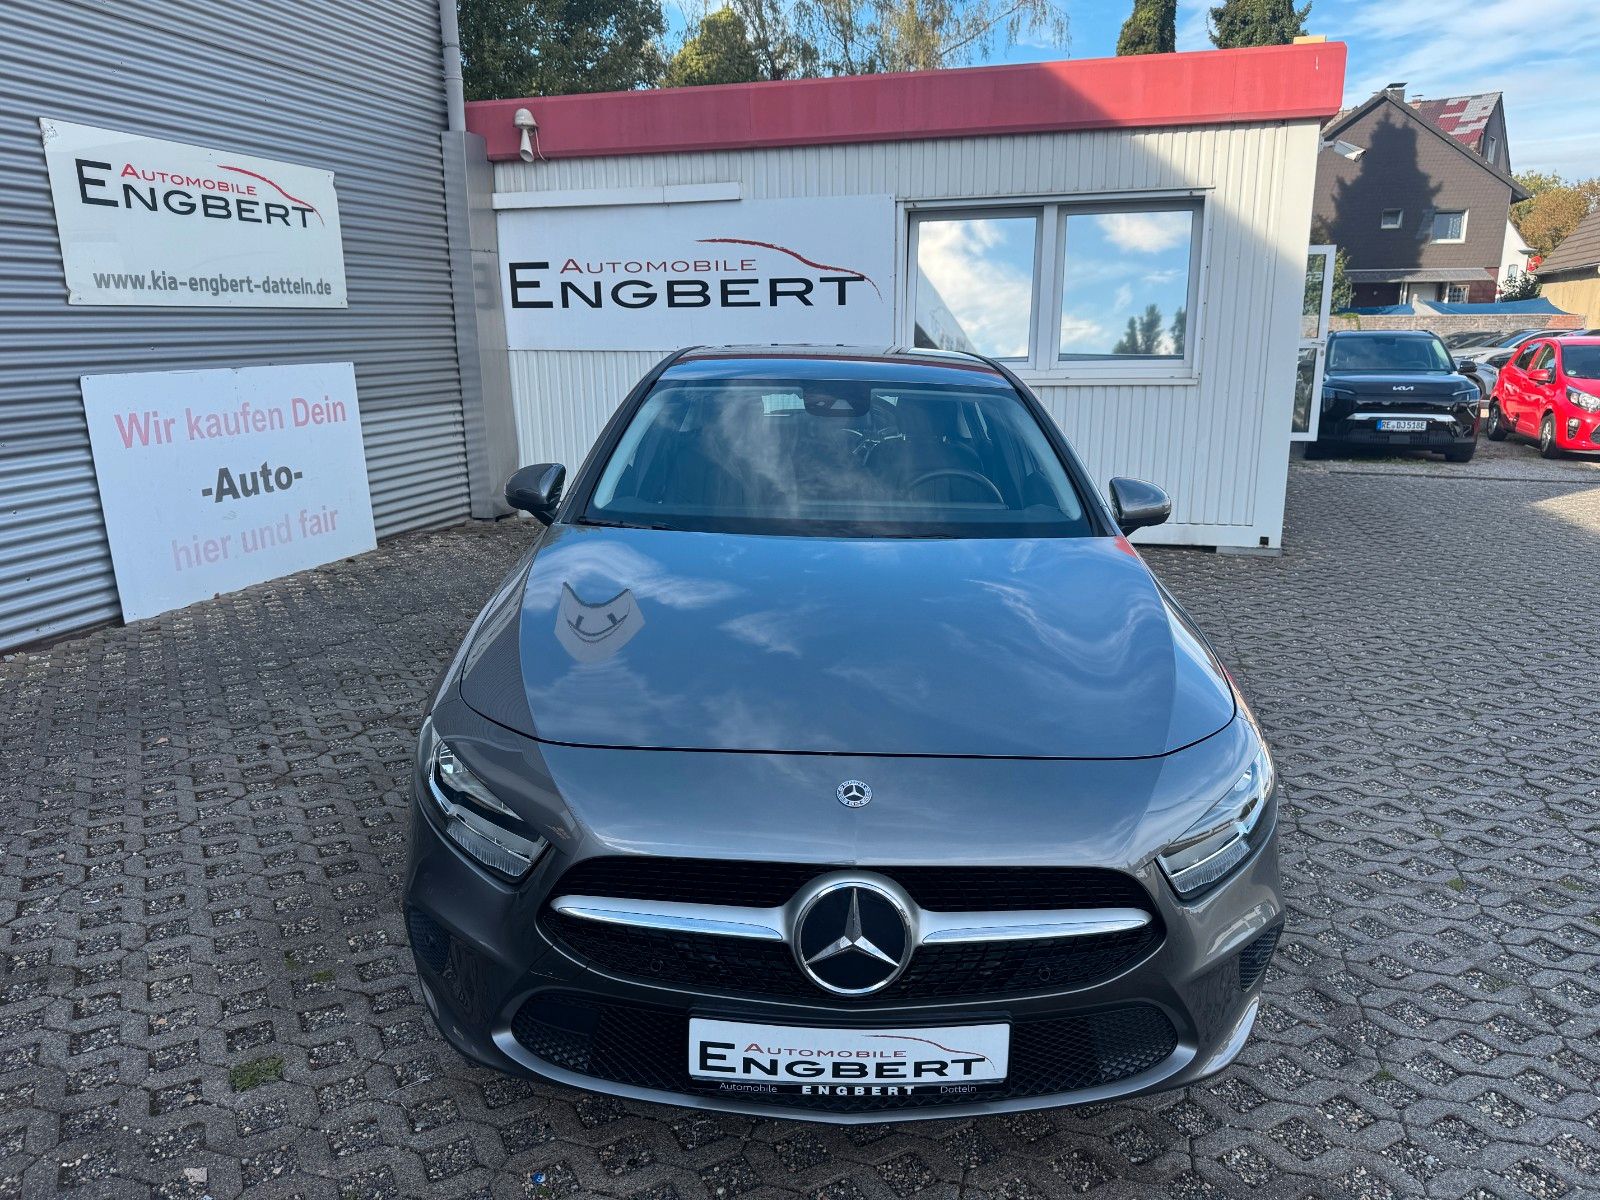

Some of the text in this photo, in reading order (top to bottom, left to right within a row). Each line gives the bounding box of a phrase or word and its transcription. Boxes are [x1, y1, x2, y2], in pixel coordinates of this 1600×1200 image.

[74, 158, 315, 228] ENGBERT
[120, 163, 258, 196] AUTOMOBILE
[92, 269, 332, 297] www.kia-engbert-datteln.de
[508, 261, 865, 309] ENGBERT
[560, 258, 757, 274] AUTOMOBILE
[114, 395, 347, 449] Wir kaufen Dein
[201, 461, 303, 503] -Auto-
[171, 505, 339, 572] hier und fair
[699, 1040, 986, 1079] ENGBERT
[743, 1042, 907, 1058] AUTOMOBILE
[719, 1082, 778, 1093] Automobile
[801, 1085, 915, 1096] ENGBERT
